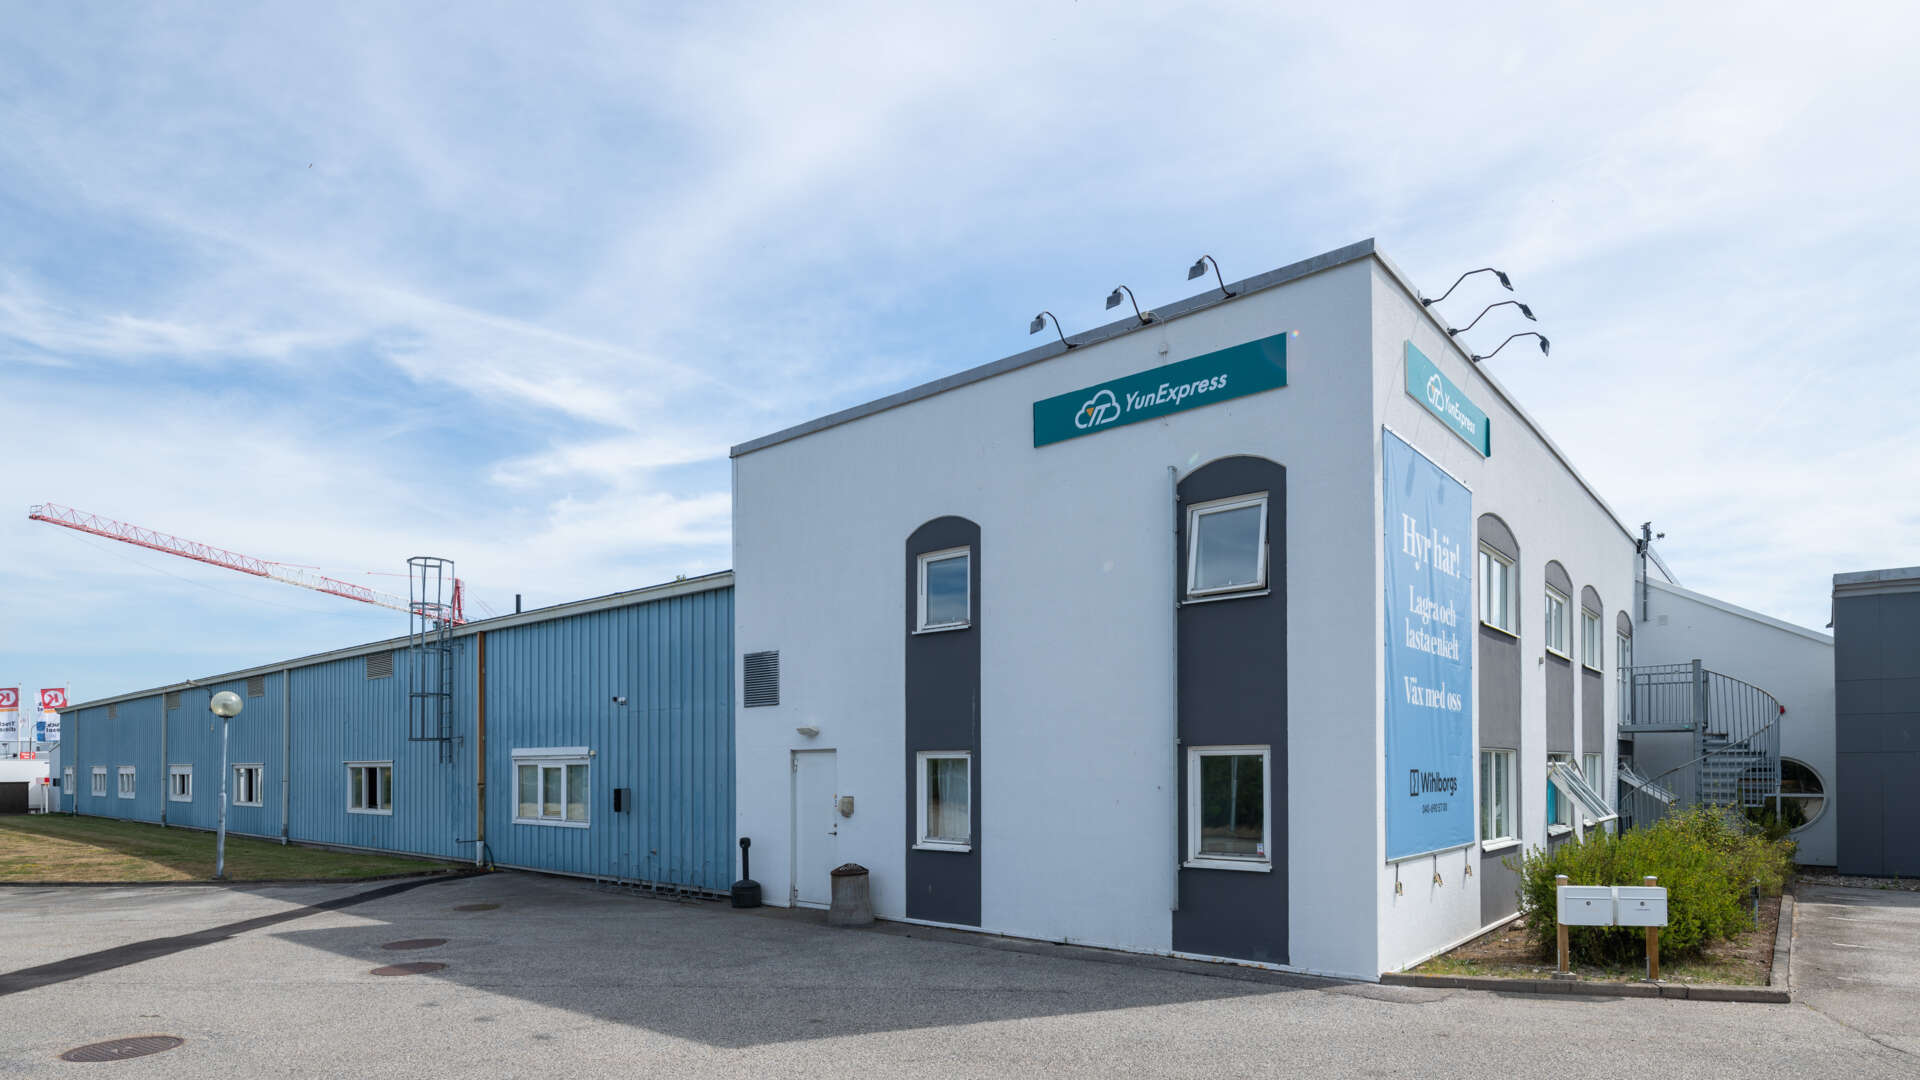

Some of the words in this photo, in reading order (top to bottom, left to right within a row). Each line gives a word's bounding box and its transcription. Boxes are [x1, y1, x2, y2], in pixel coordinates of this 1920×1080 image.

[1125, 374, 1228, 412] YunExpress
[1402, 512, 1431, 571] Hyr
[1433, 527, 1460, 579] här!
[1409, 584, 1439, 625] Lagra
[1439, 599, 1457, 627] och
[1405, 617, 1431, 653] lasta
[1431, 630, 1459, 661] enkelt
[1404, 675, 1424, 706] Väx
[1425, 681, 1446, 710] med
[1447, 691, 1462, 712] oss
[1421, 771, 1457, 796] Wihlborgs
